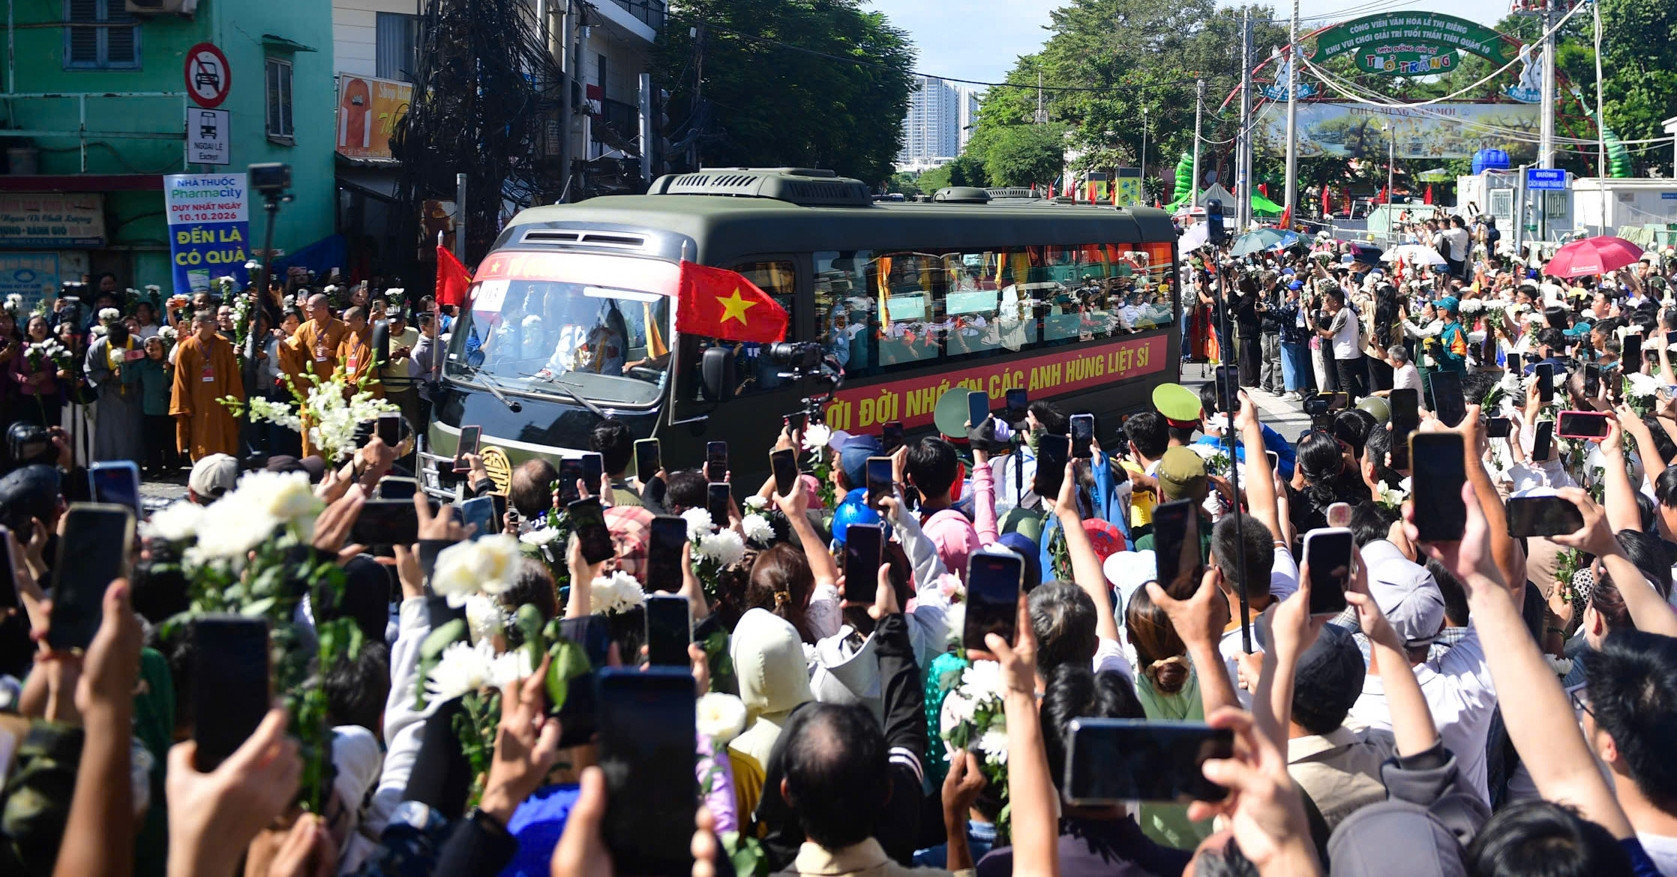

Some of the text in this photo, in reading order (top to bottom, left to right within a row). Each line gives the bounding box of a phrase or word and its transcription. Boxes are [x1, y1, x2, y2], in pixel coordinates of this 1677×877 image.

[1350, 16, 1468, 34] CÔNG VIÊN VĂN HÓA LÊ THỊ RIÊNG
[1325, 44, 1340, 55] KHU
[1342, 38, 1354, 48] VUI
[1355, 34, 1372, 44] CHƠI
[1374, 30, 1390, 40] GIẢI
[1391, 29, 1402, 38] TRÍ
[1404, 26, 1420, 37] TUỔI
[1444, 33, 1460, 43] TIÊN
[1482, 46, 1490, 54] 10
[1366, 54, 1450, 73] THỎ TRẮNG
[177, 178, 235, 187] NHÀ THUỐC
[172, 187, 242, 199] Pharmacity
[172, 202, 242, 212] DUY NHẤT NGÀY
[178, 212, 237, 221] 10.10.2026
[176, 226, 242, 244] ĐẾN LÀ
[176, 246, 246, 265] CÓ QUÀ
[826, 397, 851, 430] ỜI
[859, 388, 898, 427] ĐỜI
[989, 368, 1024, 399] CÁC
[1028, 363, 1061, 392] ANH
[1066, 354, 1104, 384] HÙNG
[1108, 346, 1134, 376] LIỆT
[1137, 342, 1150, 368] SĨ
